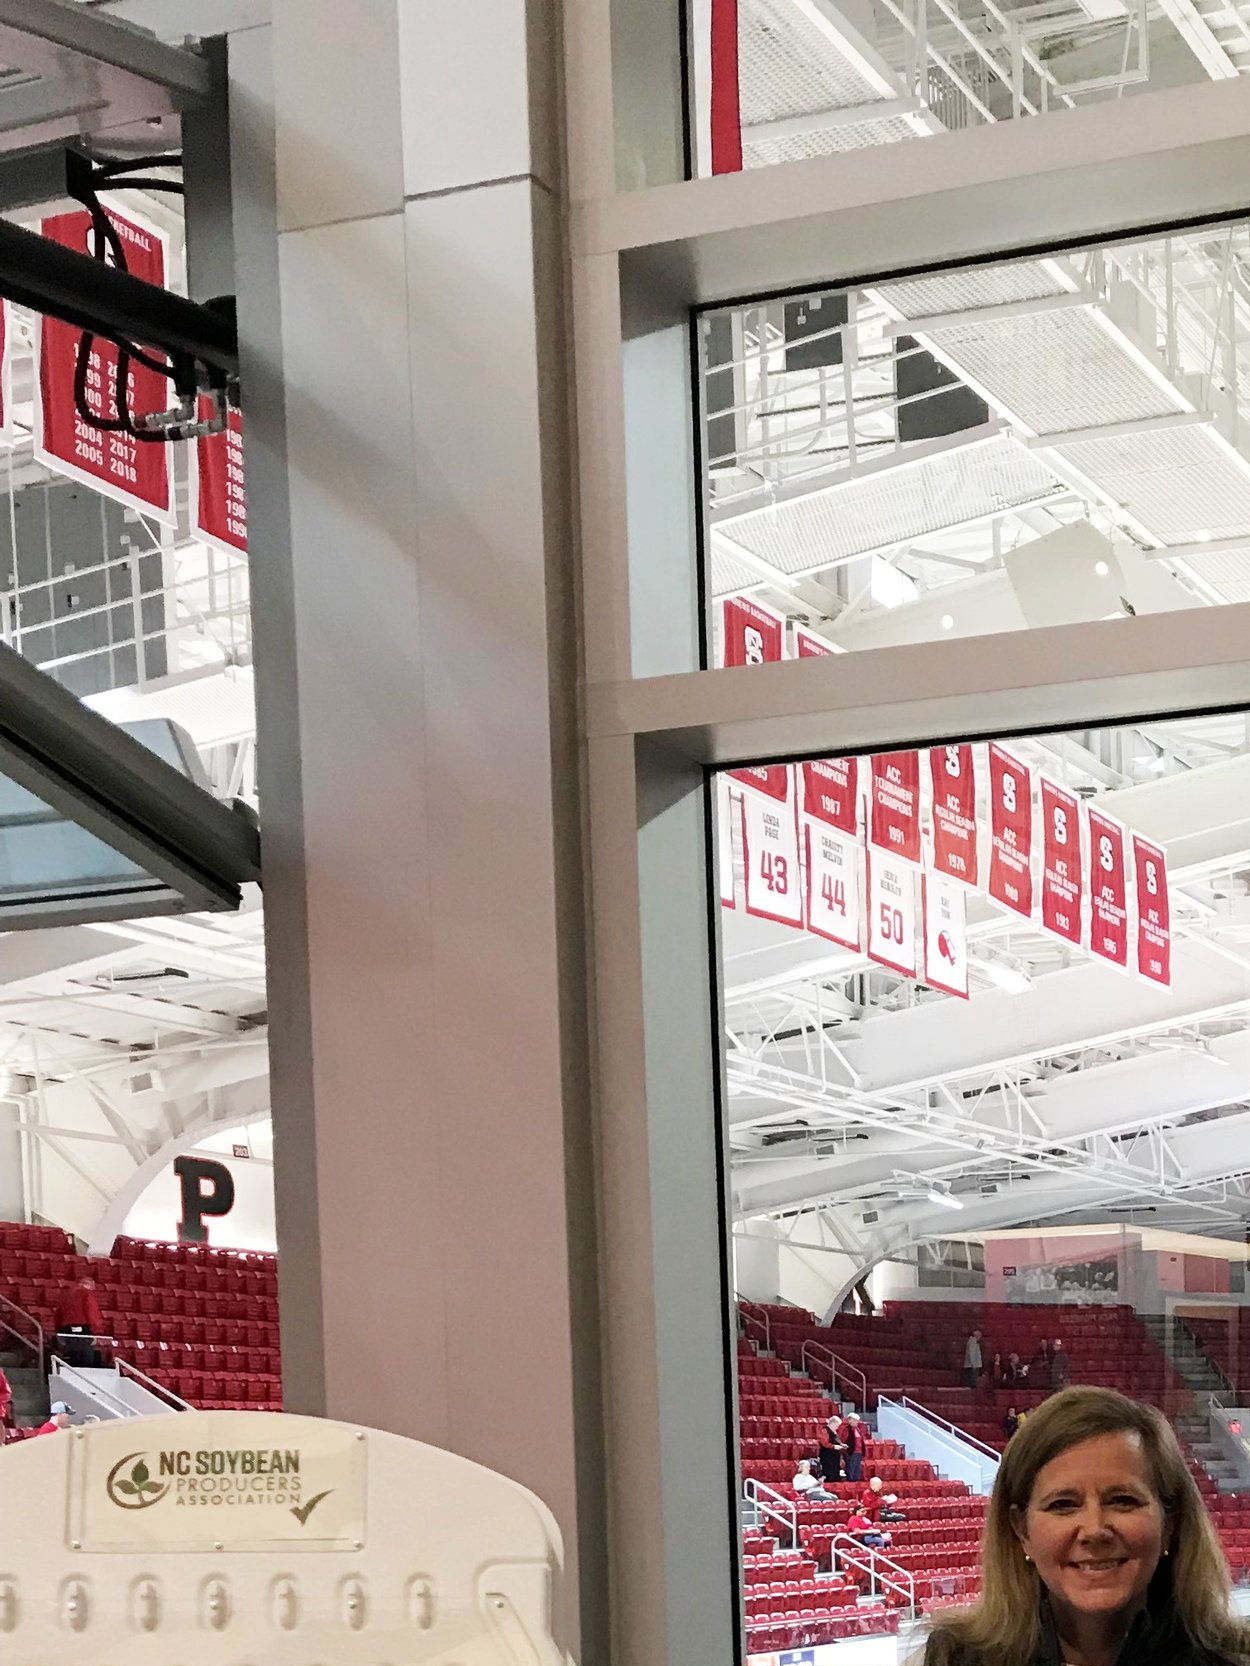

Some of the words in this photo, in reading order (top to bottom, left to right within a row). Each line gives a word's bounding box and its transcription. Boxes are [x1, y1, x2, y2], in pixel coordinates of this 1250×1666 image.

[74, 419, 103, 447] 2004
[74, 439, 104, 466] 2005
[109, 437, 137, 463] 2017
[110, 457, 138, 483] 2018
[885, 764, 902, 784] ACC
[946, 794, 961, 813] ACC
[1002, 826, 1017, 847] ACC
[760, 849, 788, 895] 43
[1055, 859, 1068, 878] ACC
[821, 872, 847, 918] 44
[1101, 885, 1115, 904] ACC
[879, 901, 904, 946] 50
[173, 1155, 235, 1244] P
[159, 1450, 192, 1476] NC
[195, 1449, 300, 1475] SOYBEAN
[176, 1476, 302, 1493] PRODUCERS
[175, 1494, 301, 1507] ASSOCIATION
